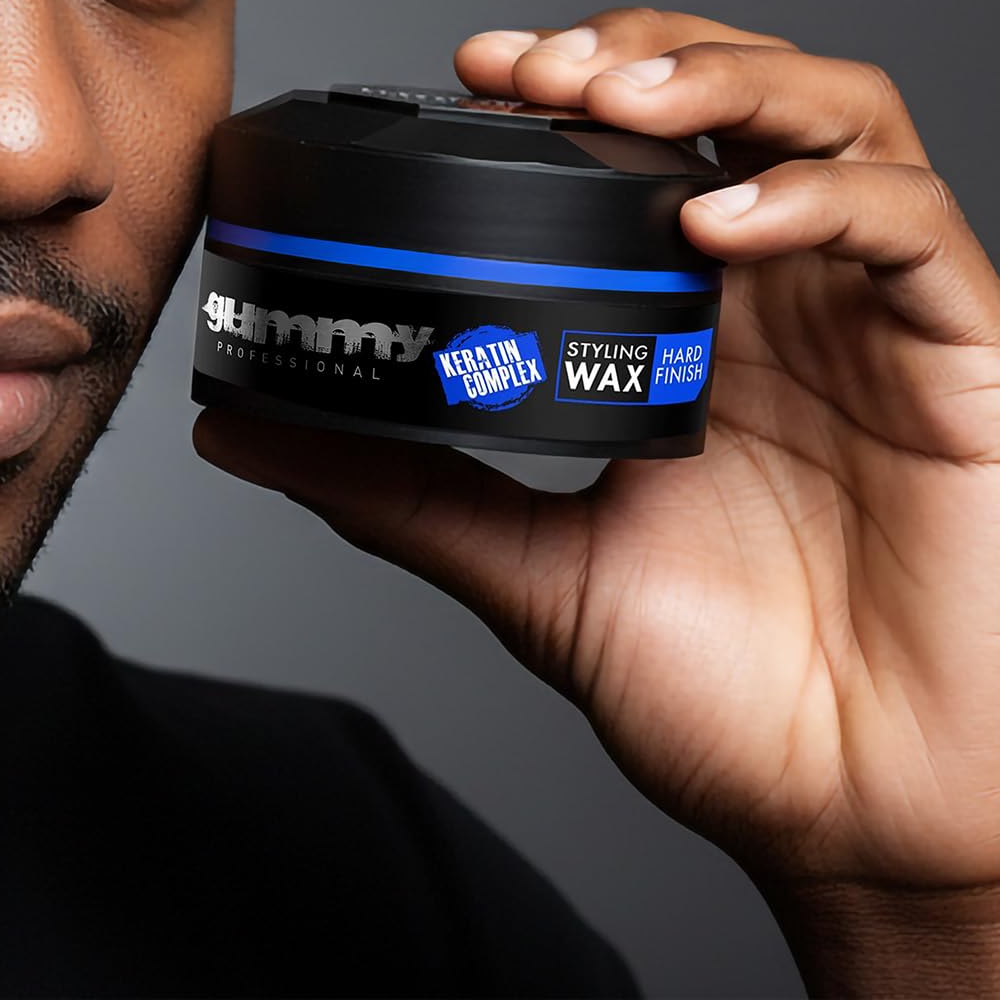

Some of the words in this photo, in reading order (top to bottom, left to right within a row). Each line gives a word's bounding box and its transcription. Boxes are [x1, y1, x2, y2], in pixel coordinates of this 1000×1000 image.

[202, 291, 435, 363] gummy
[217, 340, 381, 381] PROFESSIONAL
[438, 338, 522, 378] KERATIN
[566, 341, 649, 361] STYLING
[662, 345, 703, 366] HARD
[462, 358, 542, 400] COMPLEX
[564, 360, 646, 393] WAX
[654, 362, 704, 386] FINISH
